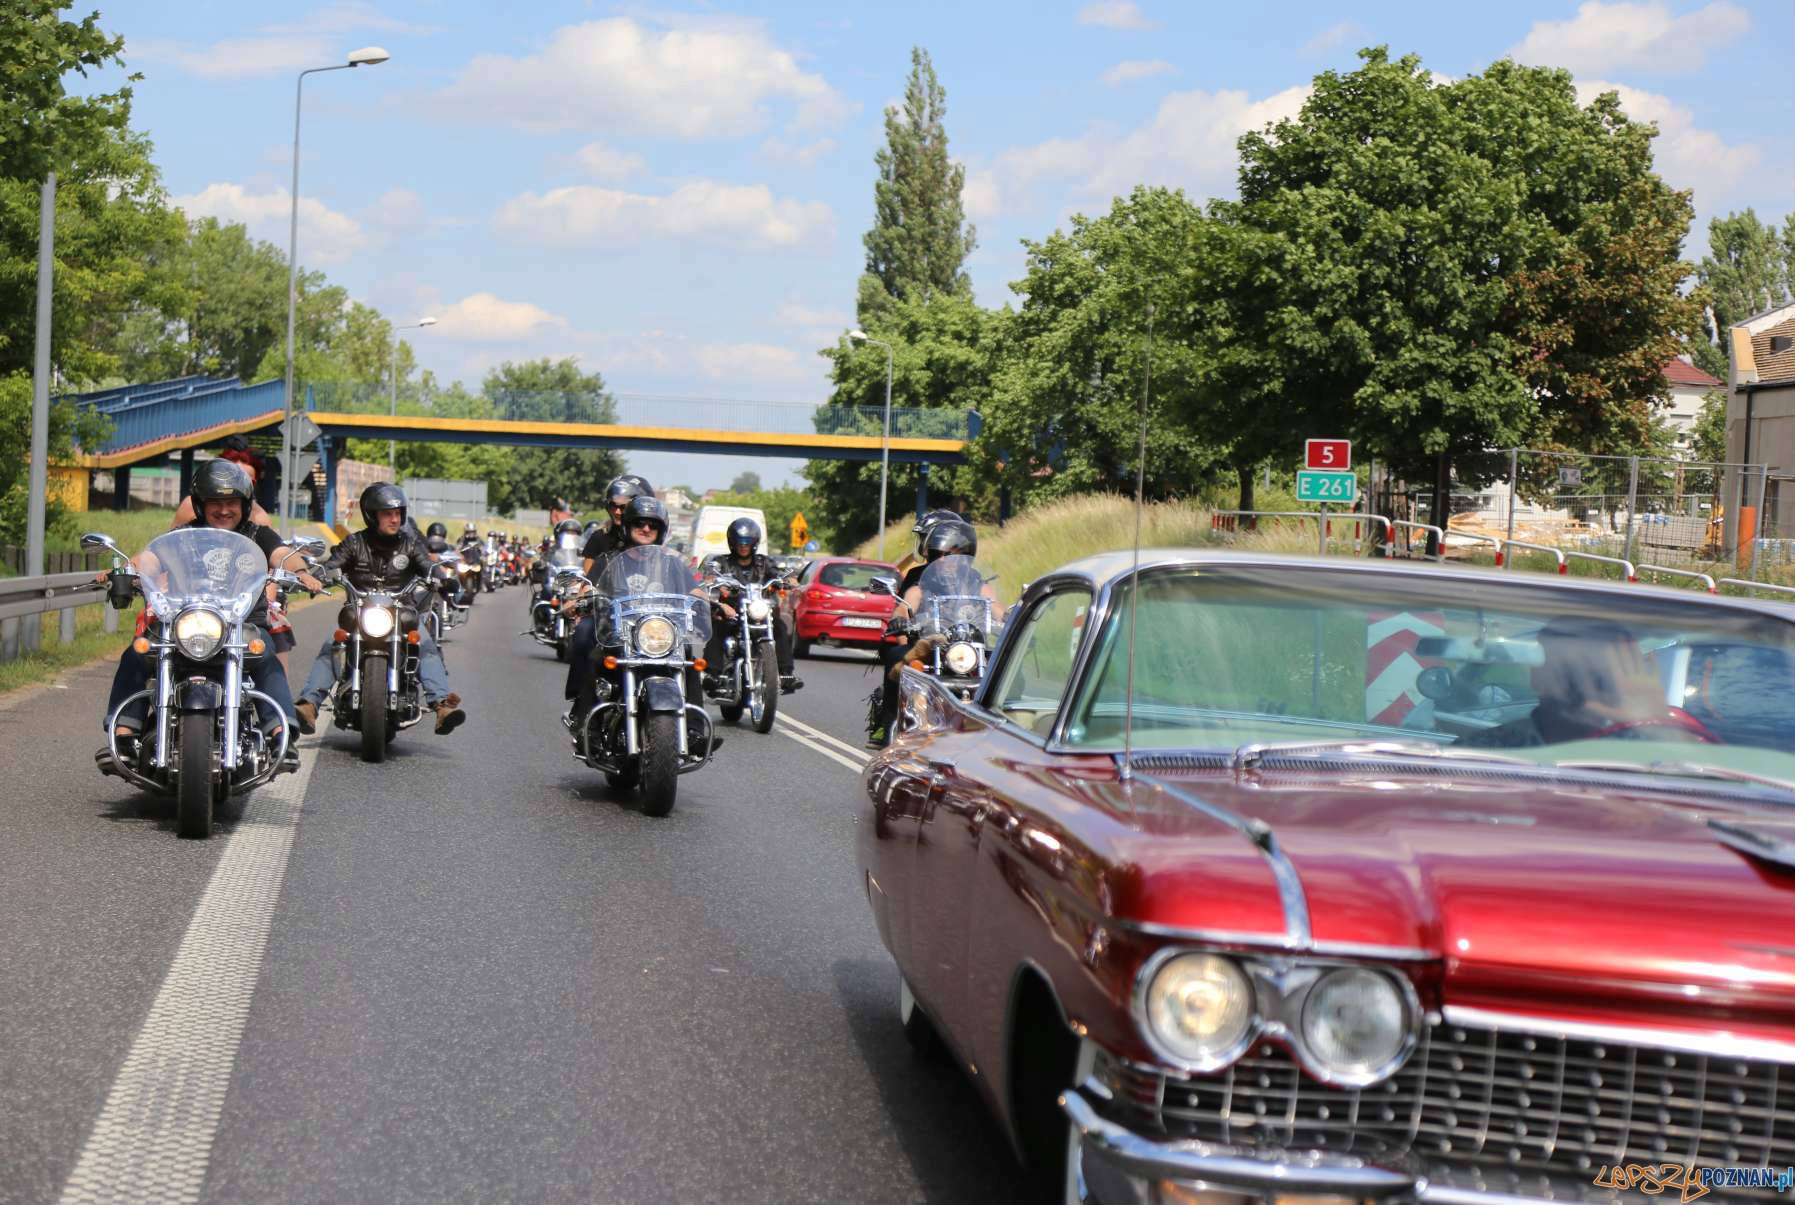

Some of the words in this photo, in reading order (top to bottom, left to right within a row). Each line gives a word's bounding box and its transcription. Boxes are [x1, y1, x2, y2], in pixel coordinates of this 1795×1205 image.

[1321, 446, 1334, 464] 5
[1301, 477, 1312, 495] E
[1318, 478, 1352, 496] 261
